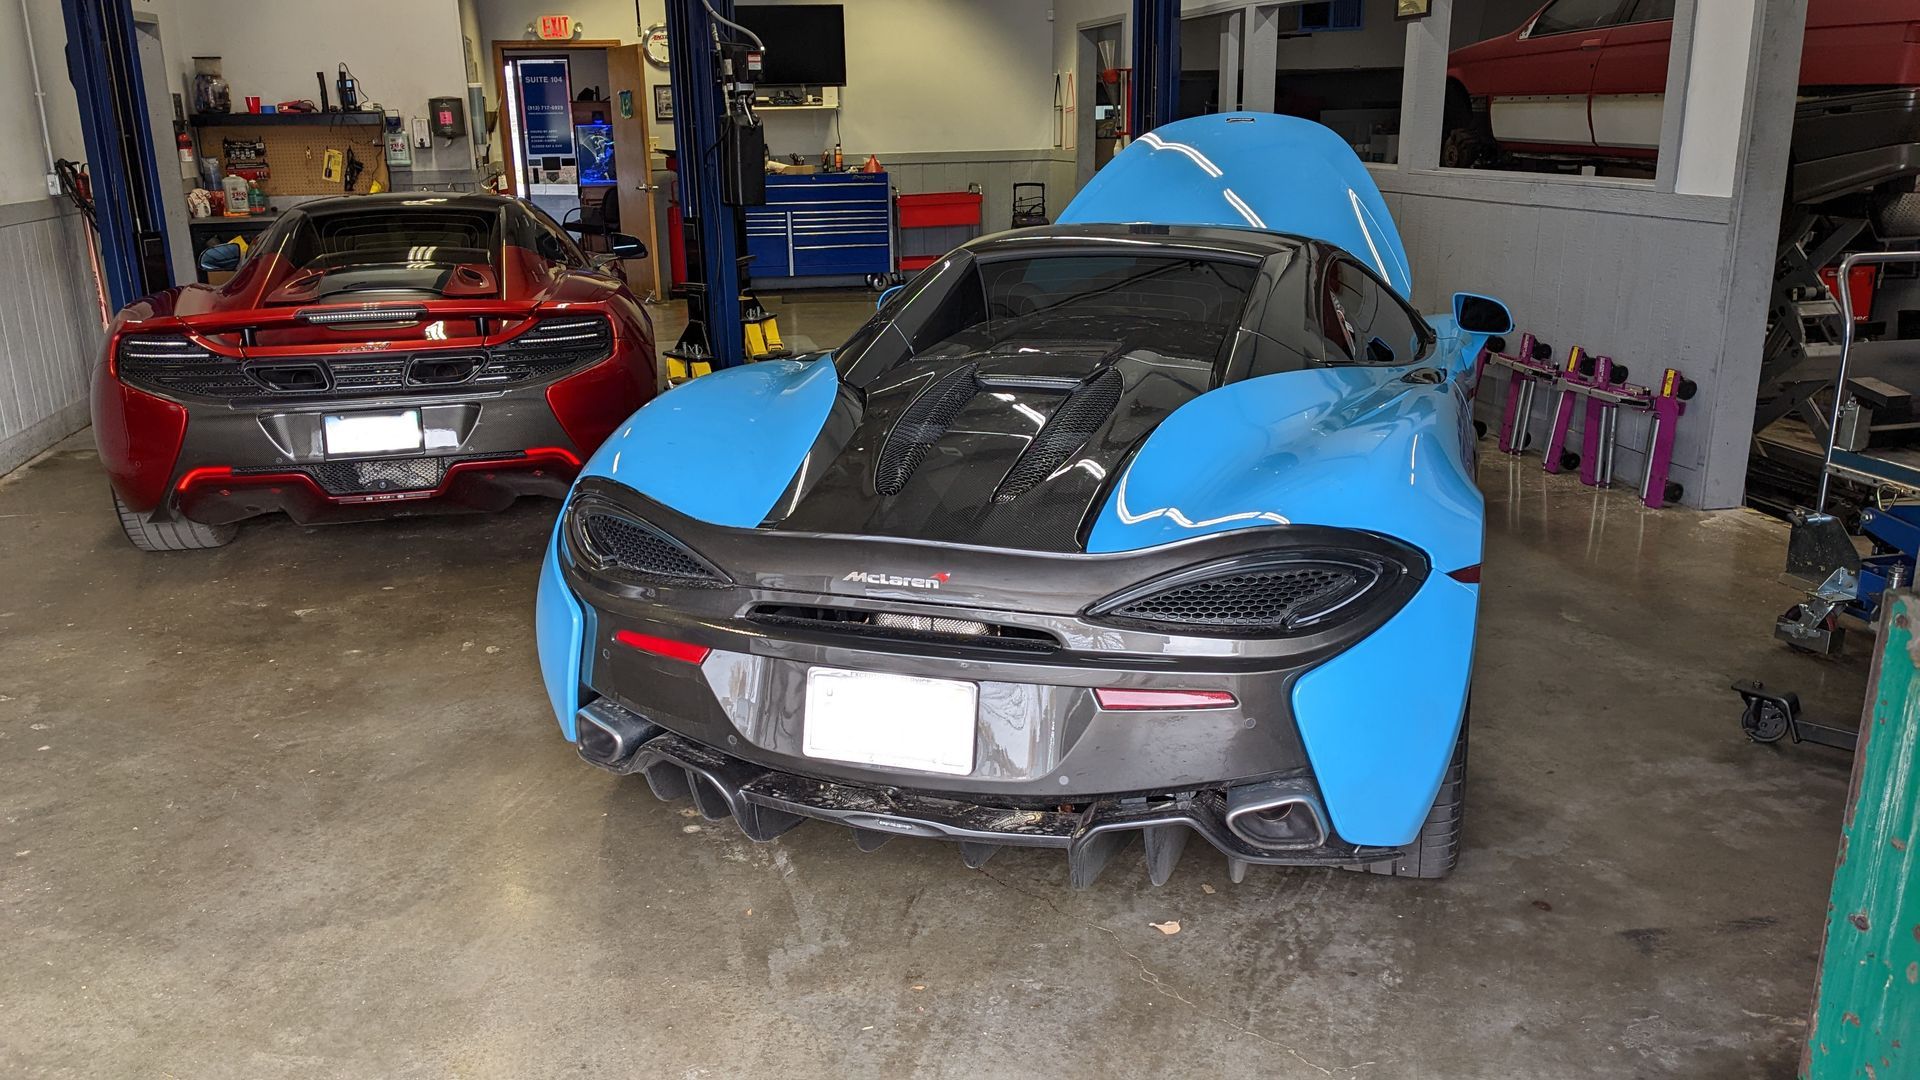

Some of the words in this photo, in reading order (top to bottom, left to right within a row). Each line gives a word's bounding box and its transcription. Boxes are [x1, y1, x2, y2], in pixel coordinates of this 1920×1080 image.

[542, 16, 569, 37] EXIT
[525, 76, 549, 84] SUITE
[550, 76, 563, 84] 104
[842, 571, 940, 589] McLaren
